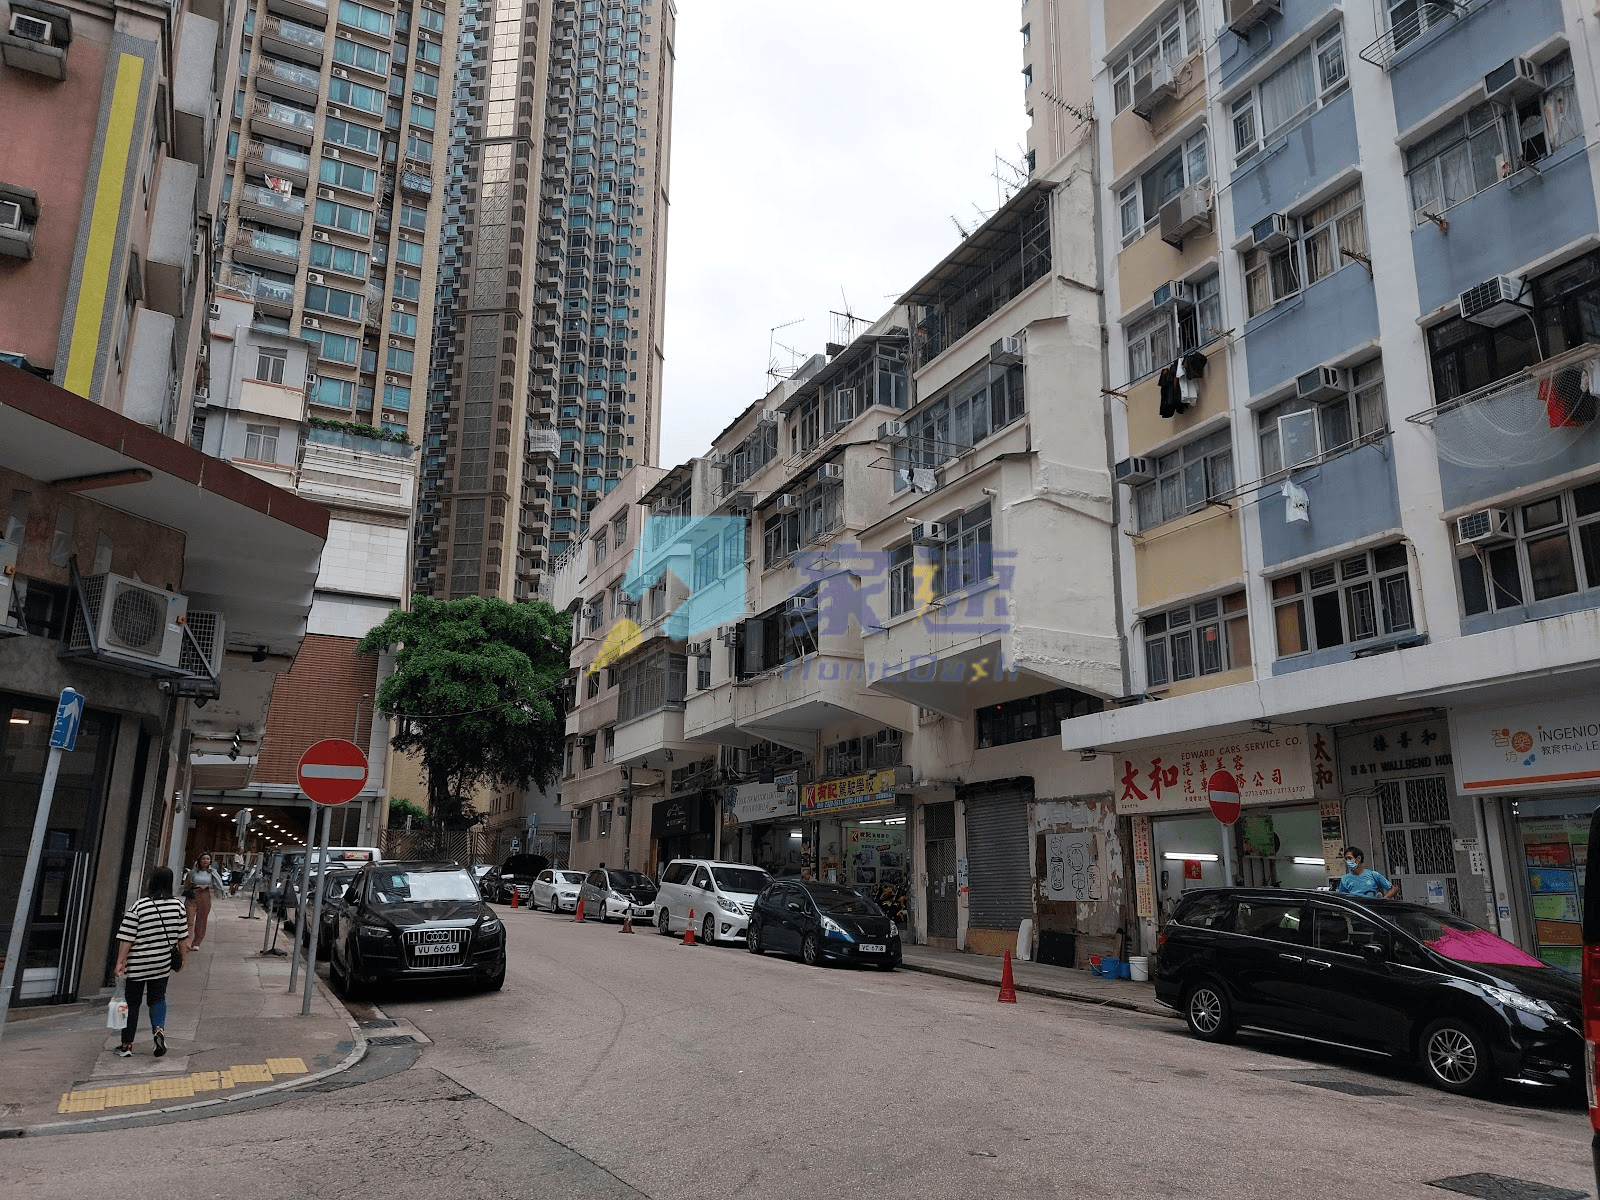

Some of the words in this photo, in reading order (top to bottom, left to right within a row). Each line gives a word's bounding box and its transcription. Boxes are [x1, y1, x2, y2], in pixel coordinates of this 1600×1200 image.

[1181, 749, 1215, 761] EDWARD
[1219, 744, 1241, 756] CARS
[1245, 738, 1280, 752] SERVICE
[1285, 736, 1302, 746] CO.
[1313, 732, 1333, 790] 太和
[1541, 742, 1583, 756] 教育中心
[1120, 757, 1179, 801] 太和
[1183, 768, 1283, 794] 汽車務公司
[418, 946, 430, 954] VU
[433, 944, 457, 953] 6669
